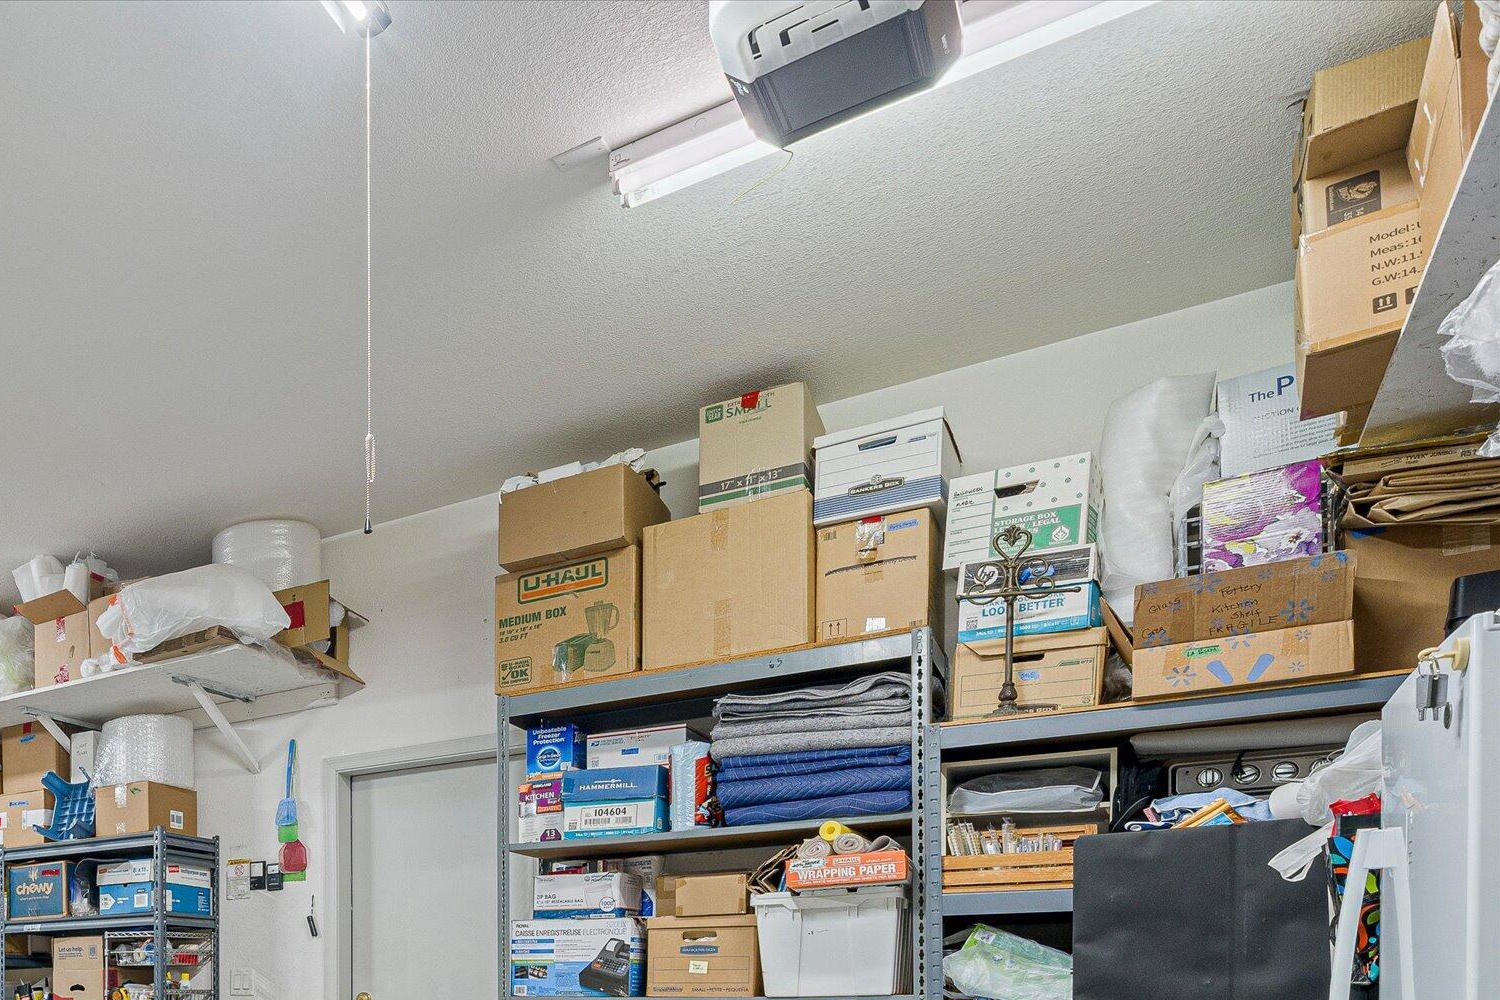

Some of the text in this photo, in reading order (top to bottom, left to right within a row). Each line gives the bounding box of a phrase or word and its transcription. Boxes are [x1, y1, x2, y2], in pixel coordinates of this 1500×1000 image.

[1249, 390, 1275, 402] The
[850, 480, 900, 495] BANKERS BOX
[994, 511, 1057, 527] STORAGE BOX
[1033, 517, 1061, 527] LEGAL
[523, 563, 602, 592] U-HAUL
[982, 604, 1007, 617] LOO
[1019, 596, 1064, 613] BETTER
[499, 606, 567, 629] MEDIUM BOX
[511, 669, 528, 678] OK
[532, 726, 567, 736] Unbeatable
[538, 732, 561, 740] Freezer
[533, 738, 565, 746] Protection
[580, 782, 637, 790] HAMMERMILL
[525, 792, 554, 801] KITCHEN
[594, 807, 627, 816] 104604
[546, 829, 556, 837] 13
[799, 864, 896, 880] WRAPPING PAPER
[16, 883, 53, 896] chewy
